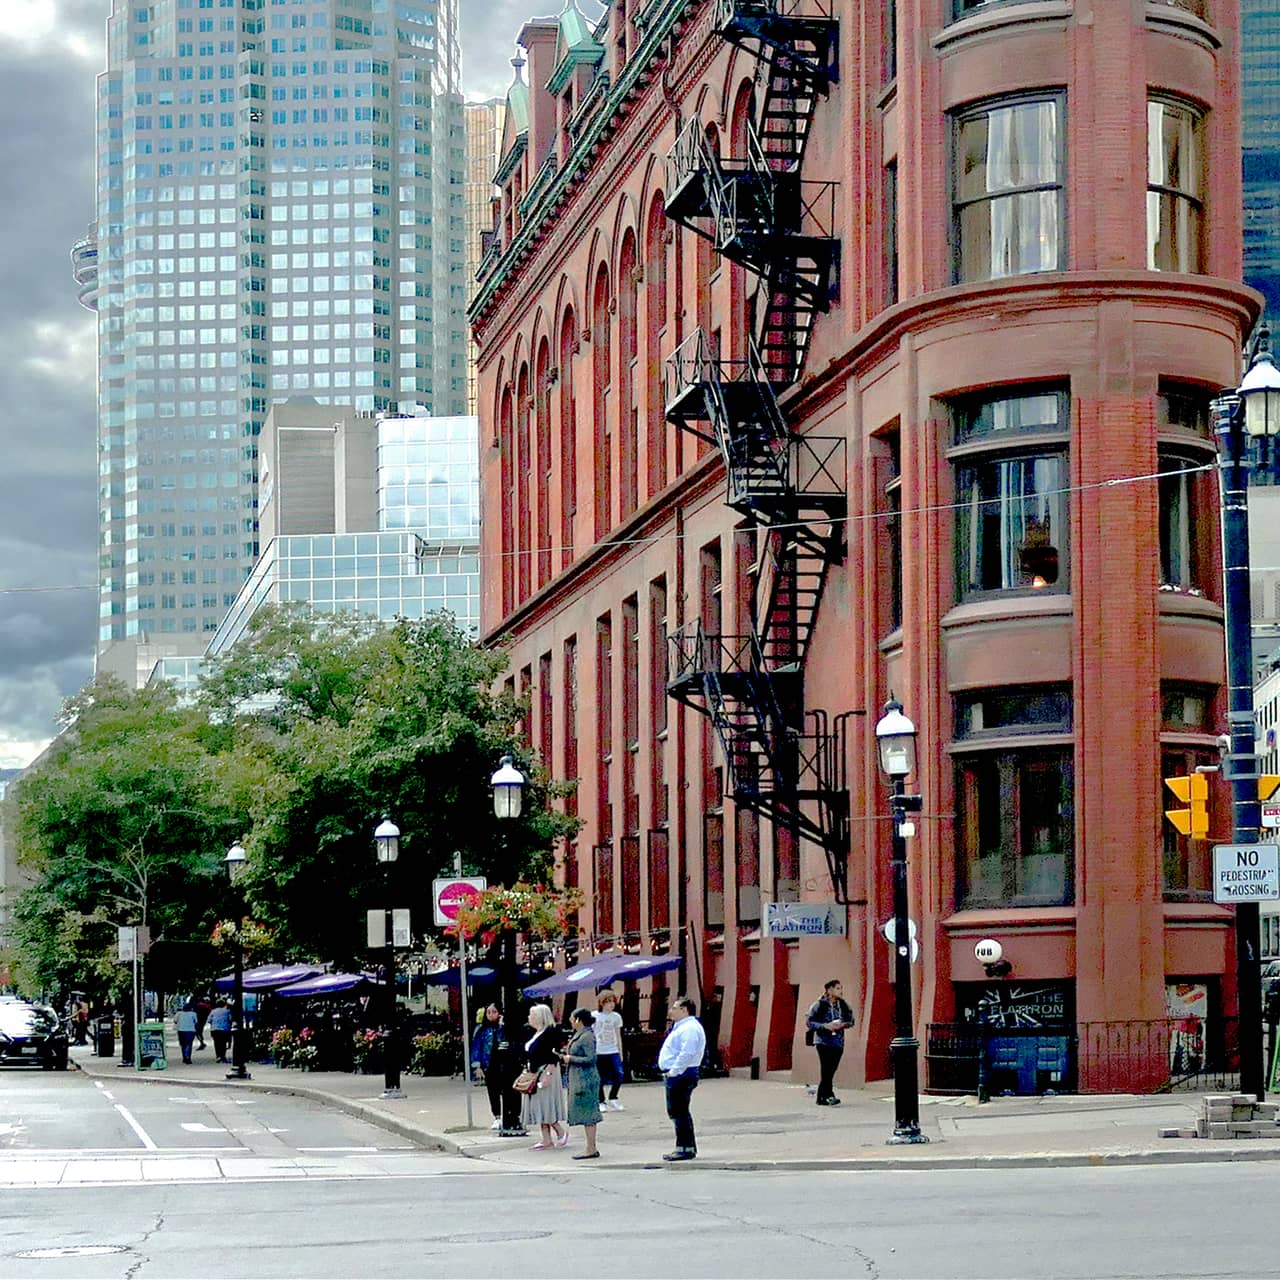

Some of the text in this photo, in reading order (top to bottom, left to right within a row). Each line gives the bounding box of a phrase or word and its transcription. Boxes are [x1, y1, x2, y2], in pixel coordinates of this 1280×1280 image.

[1236, 850, 1260, 867] NO
[1220, 869, 1274, 882] PEDESTRIA
[1223, 883, 1270, 897] ROSSING
